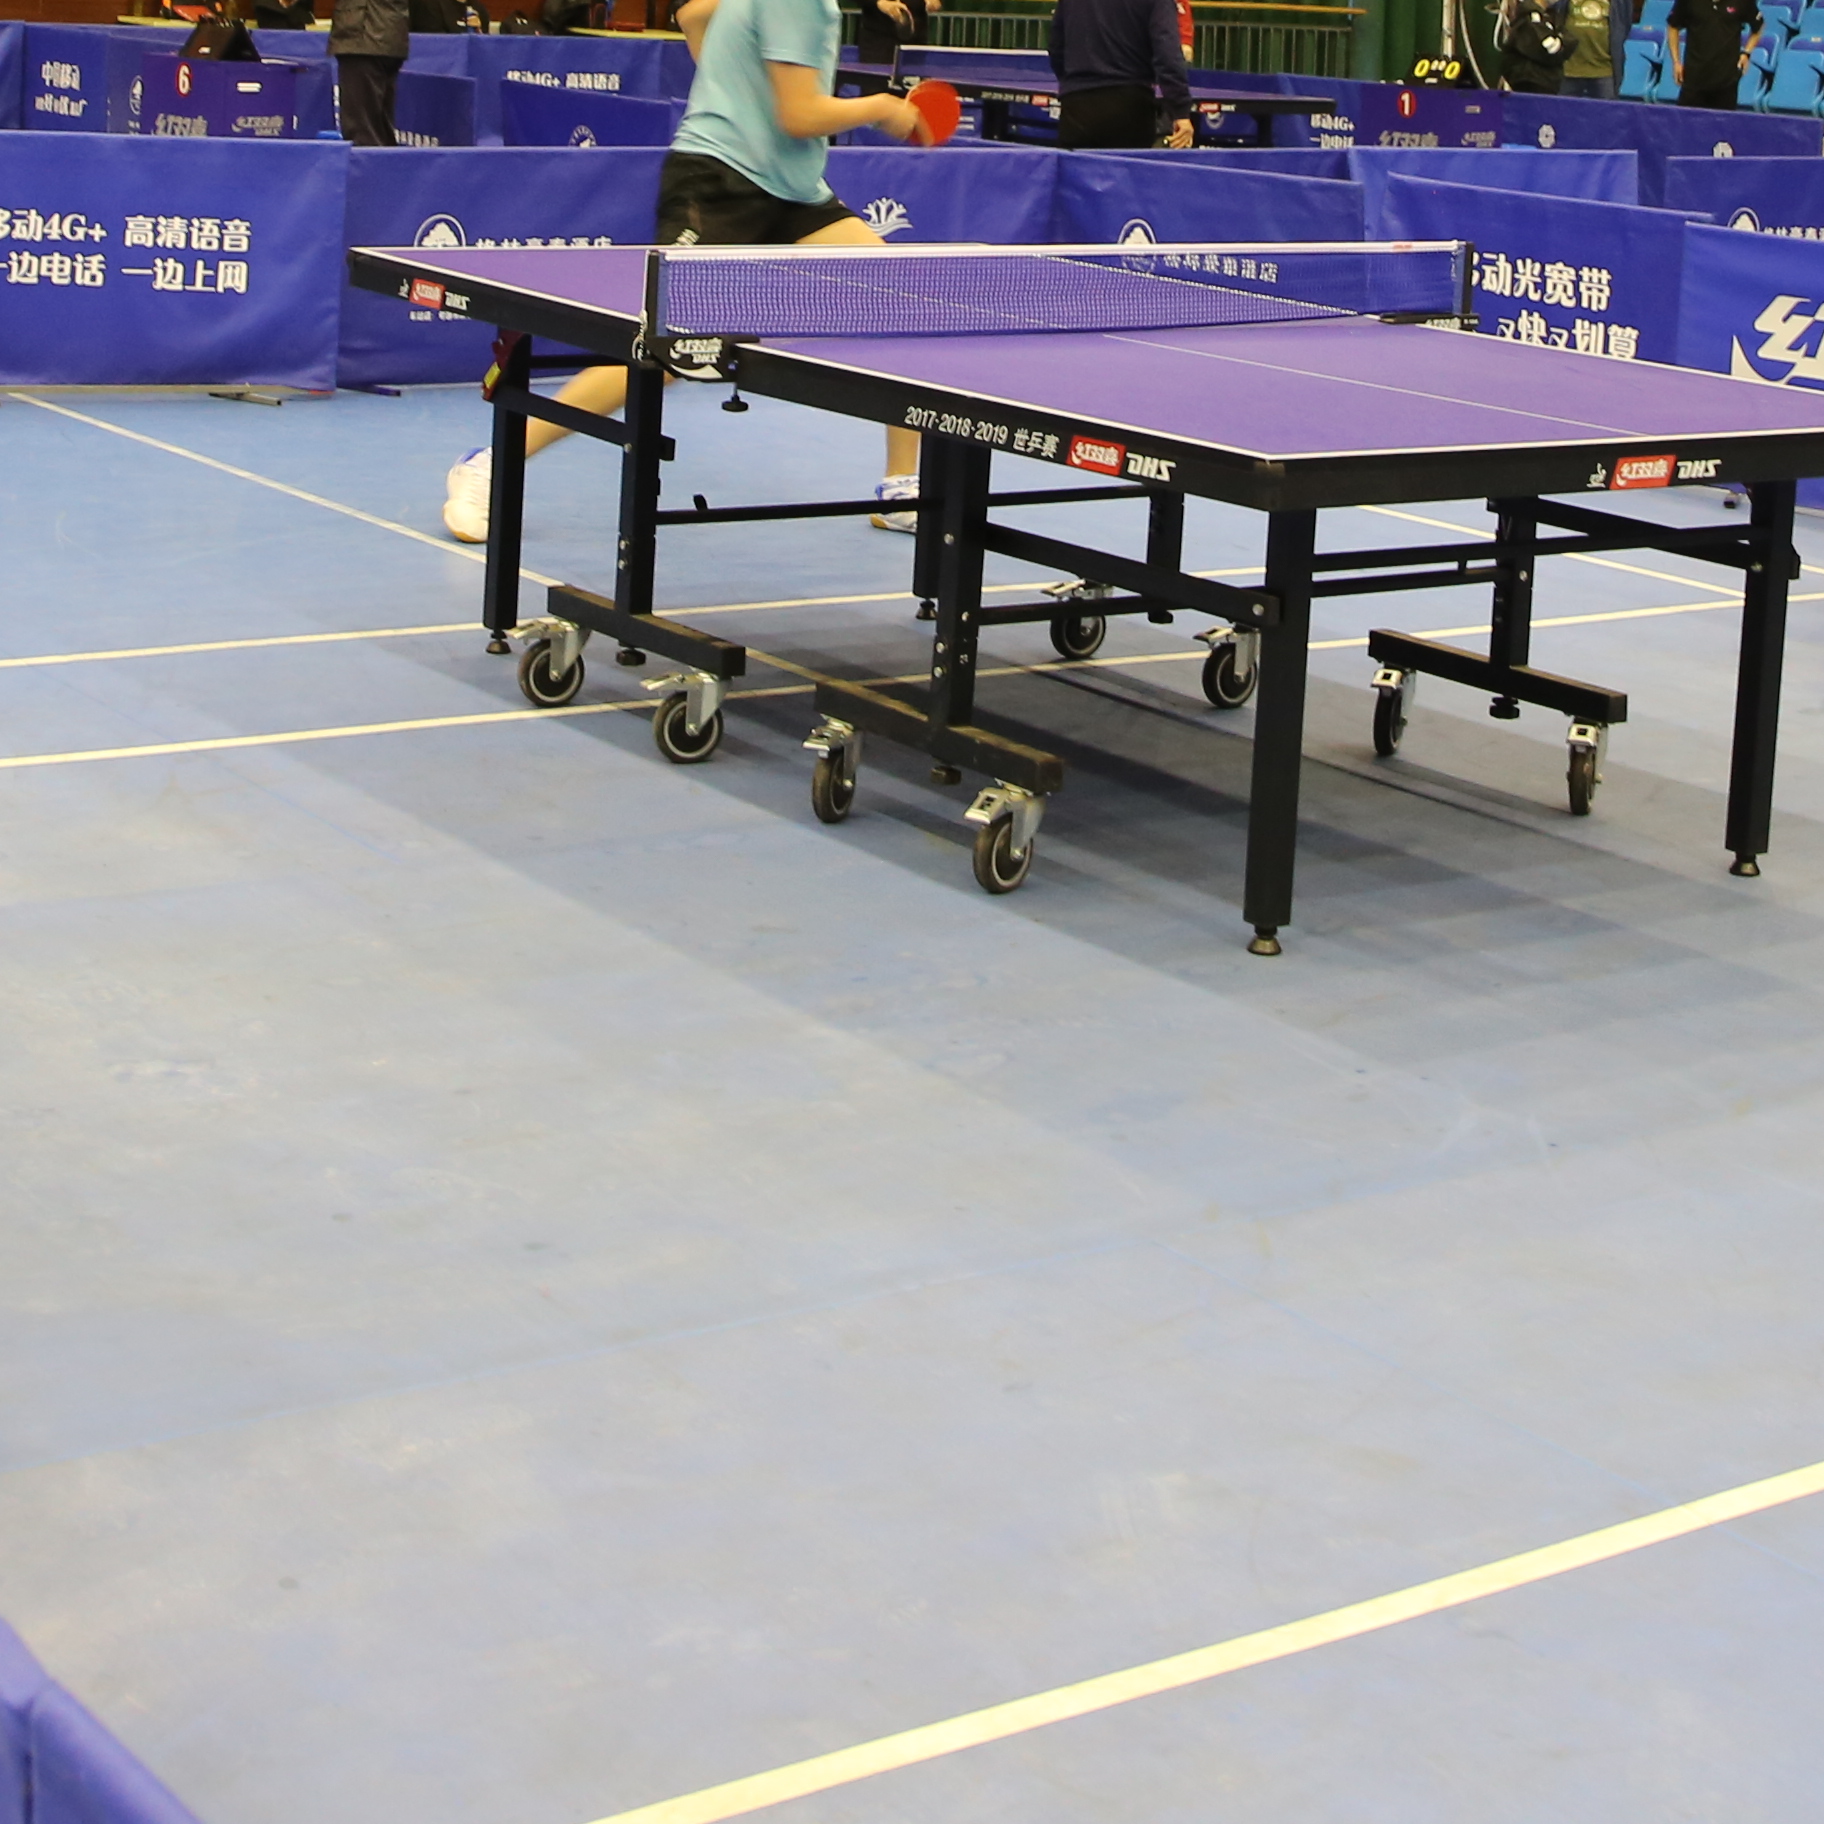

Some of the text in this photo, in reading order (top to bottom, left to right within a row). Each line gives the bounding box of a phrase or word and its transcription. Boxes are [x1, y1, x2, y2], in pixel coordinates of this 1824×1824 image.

[178, 61, 190, 95] 6
[1414, 58, 1430, 78] 0
[1444, 61, 1461, 80] 0
[1401, 92, 1411, 116] 1
[123, 215, 252, 252] 高清语音
[121, 257, 249, 294] 一边上网
[1472, 249, 1613, 312] 动光宽带
[445, 291, 471, 310] DHS
[1013, 428, 1061, 460] 世乒赛
[1126, 452, 1176, 483] DHS
[1676, 458, 1722, 479] DHS
